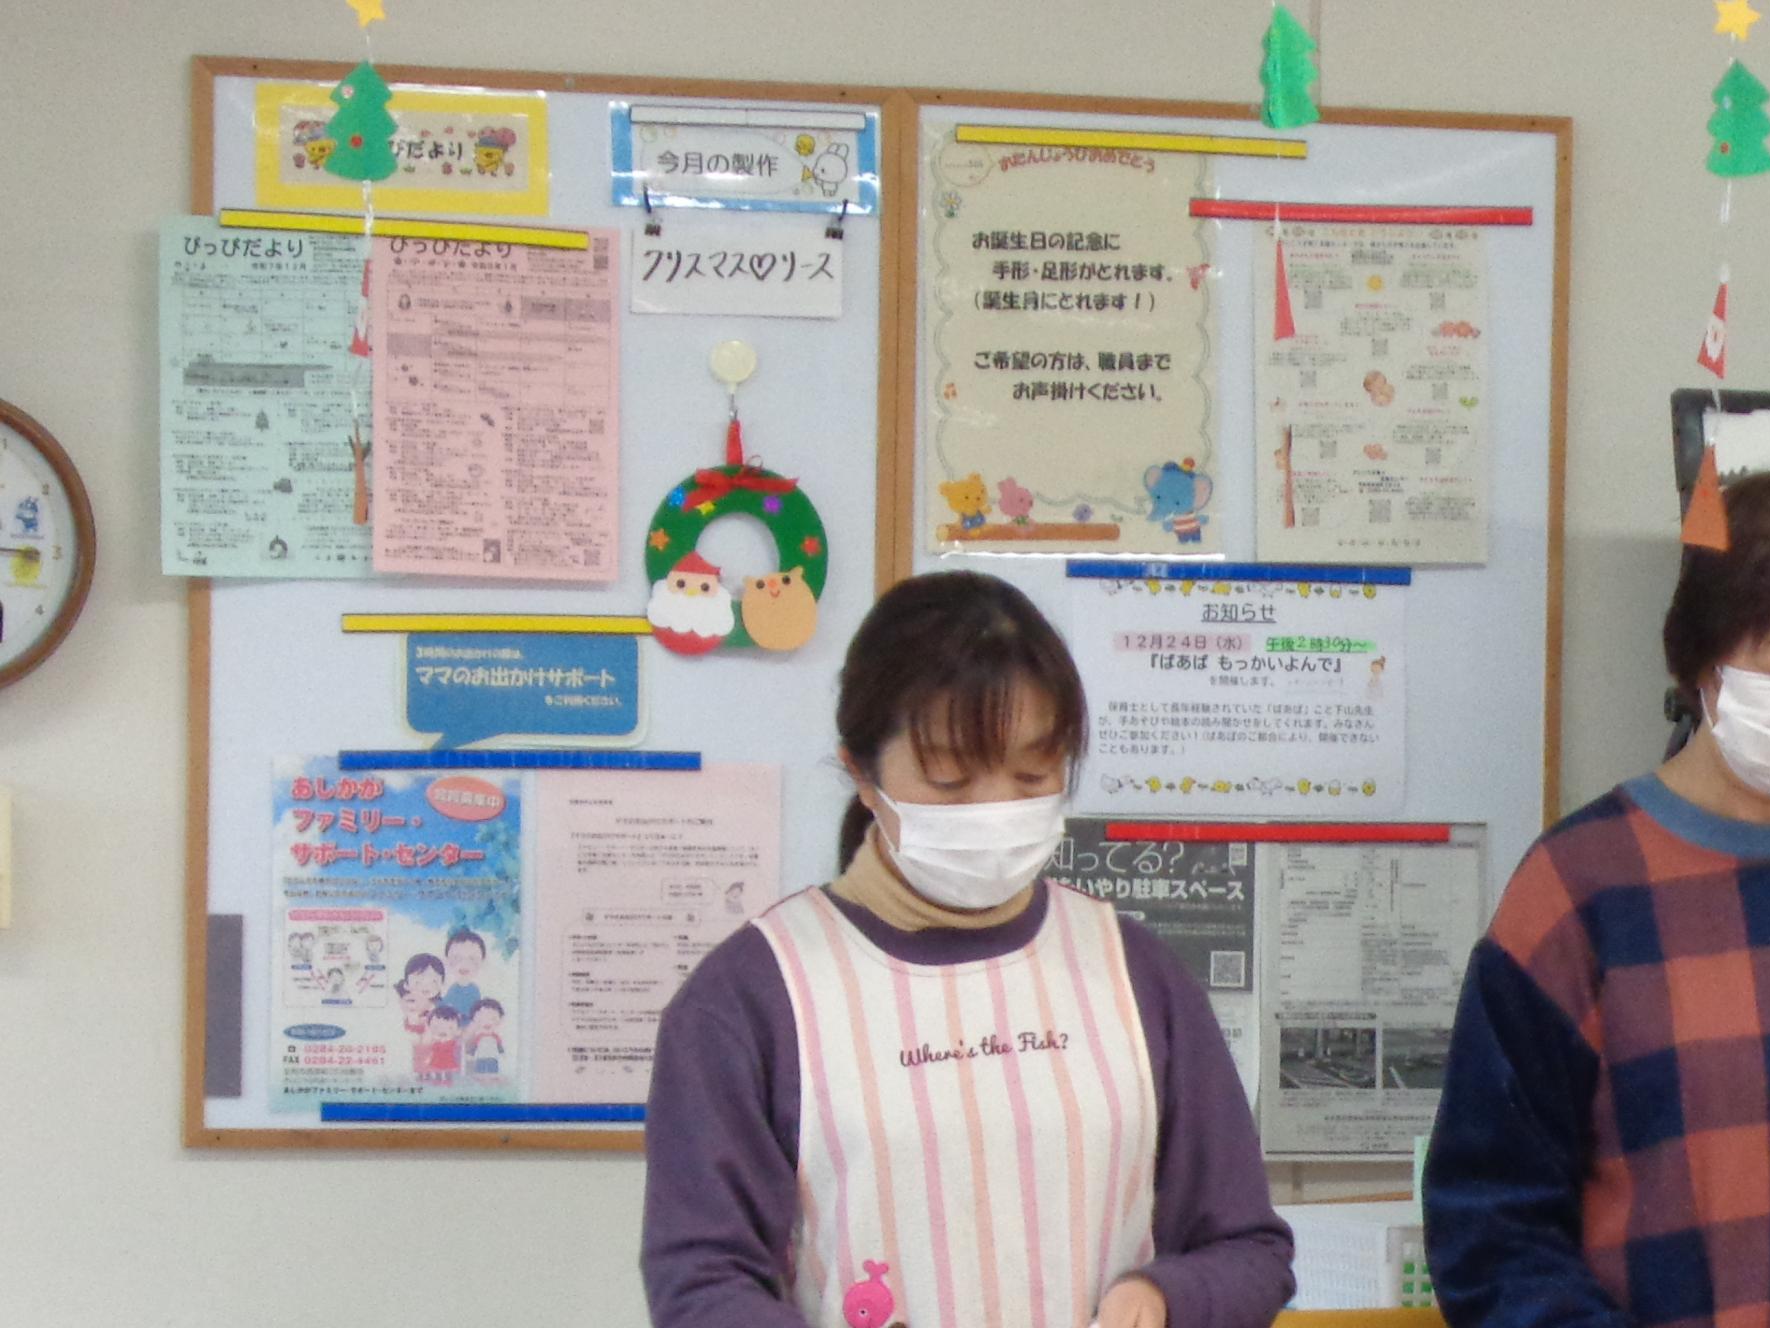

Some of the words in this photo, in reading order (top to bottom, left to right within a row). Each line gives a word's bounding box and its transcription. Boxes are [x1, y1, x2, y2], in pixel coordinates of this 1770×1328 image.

[657, 150, 779, 177] 今月の製作
[184, 236, 303, 258] ぴっぴだより
[972, 230, 1121, 251] お誕生日の記念に
[974, 351, 1172, 371] ご希望の方は、職員まで
[1012, 381, 1162, 401] お声掛けください。
[1201, 602, 1277, 623] お知らせ
[415, 665, 616, 689] ママのお出かけサポート
[291, 842, 486, 867] サポート・センター
[900, 1039, 978, 1067] Where's
[979, 1034, 1013, 1056] the
[1017, 1030, 1069, 1052] Fish?
